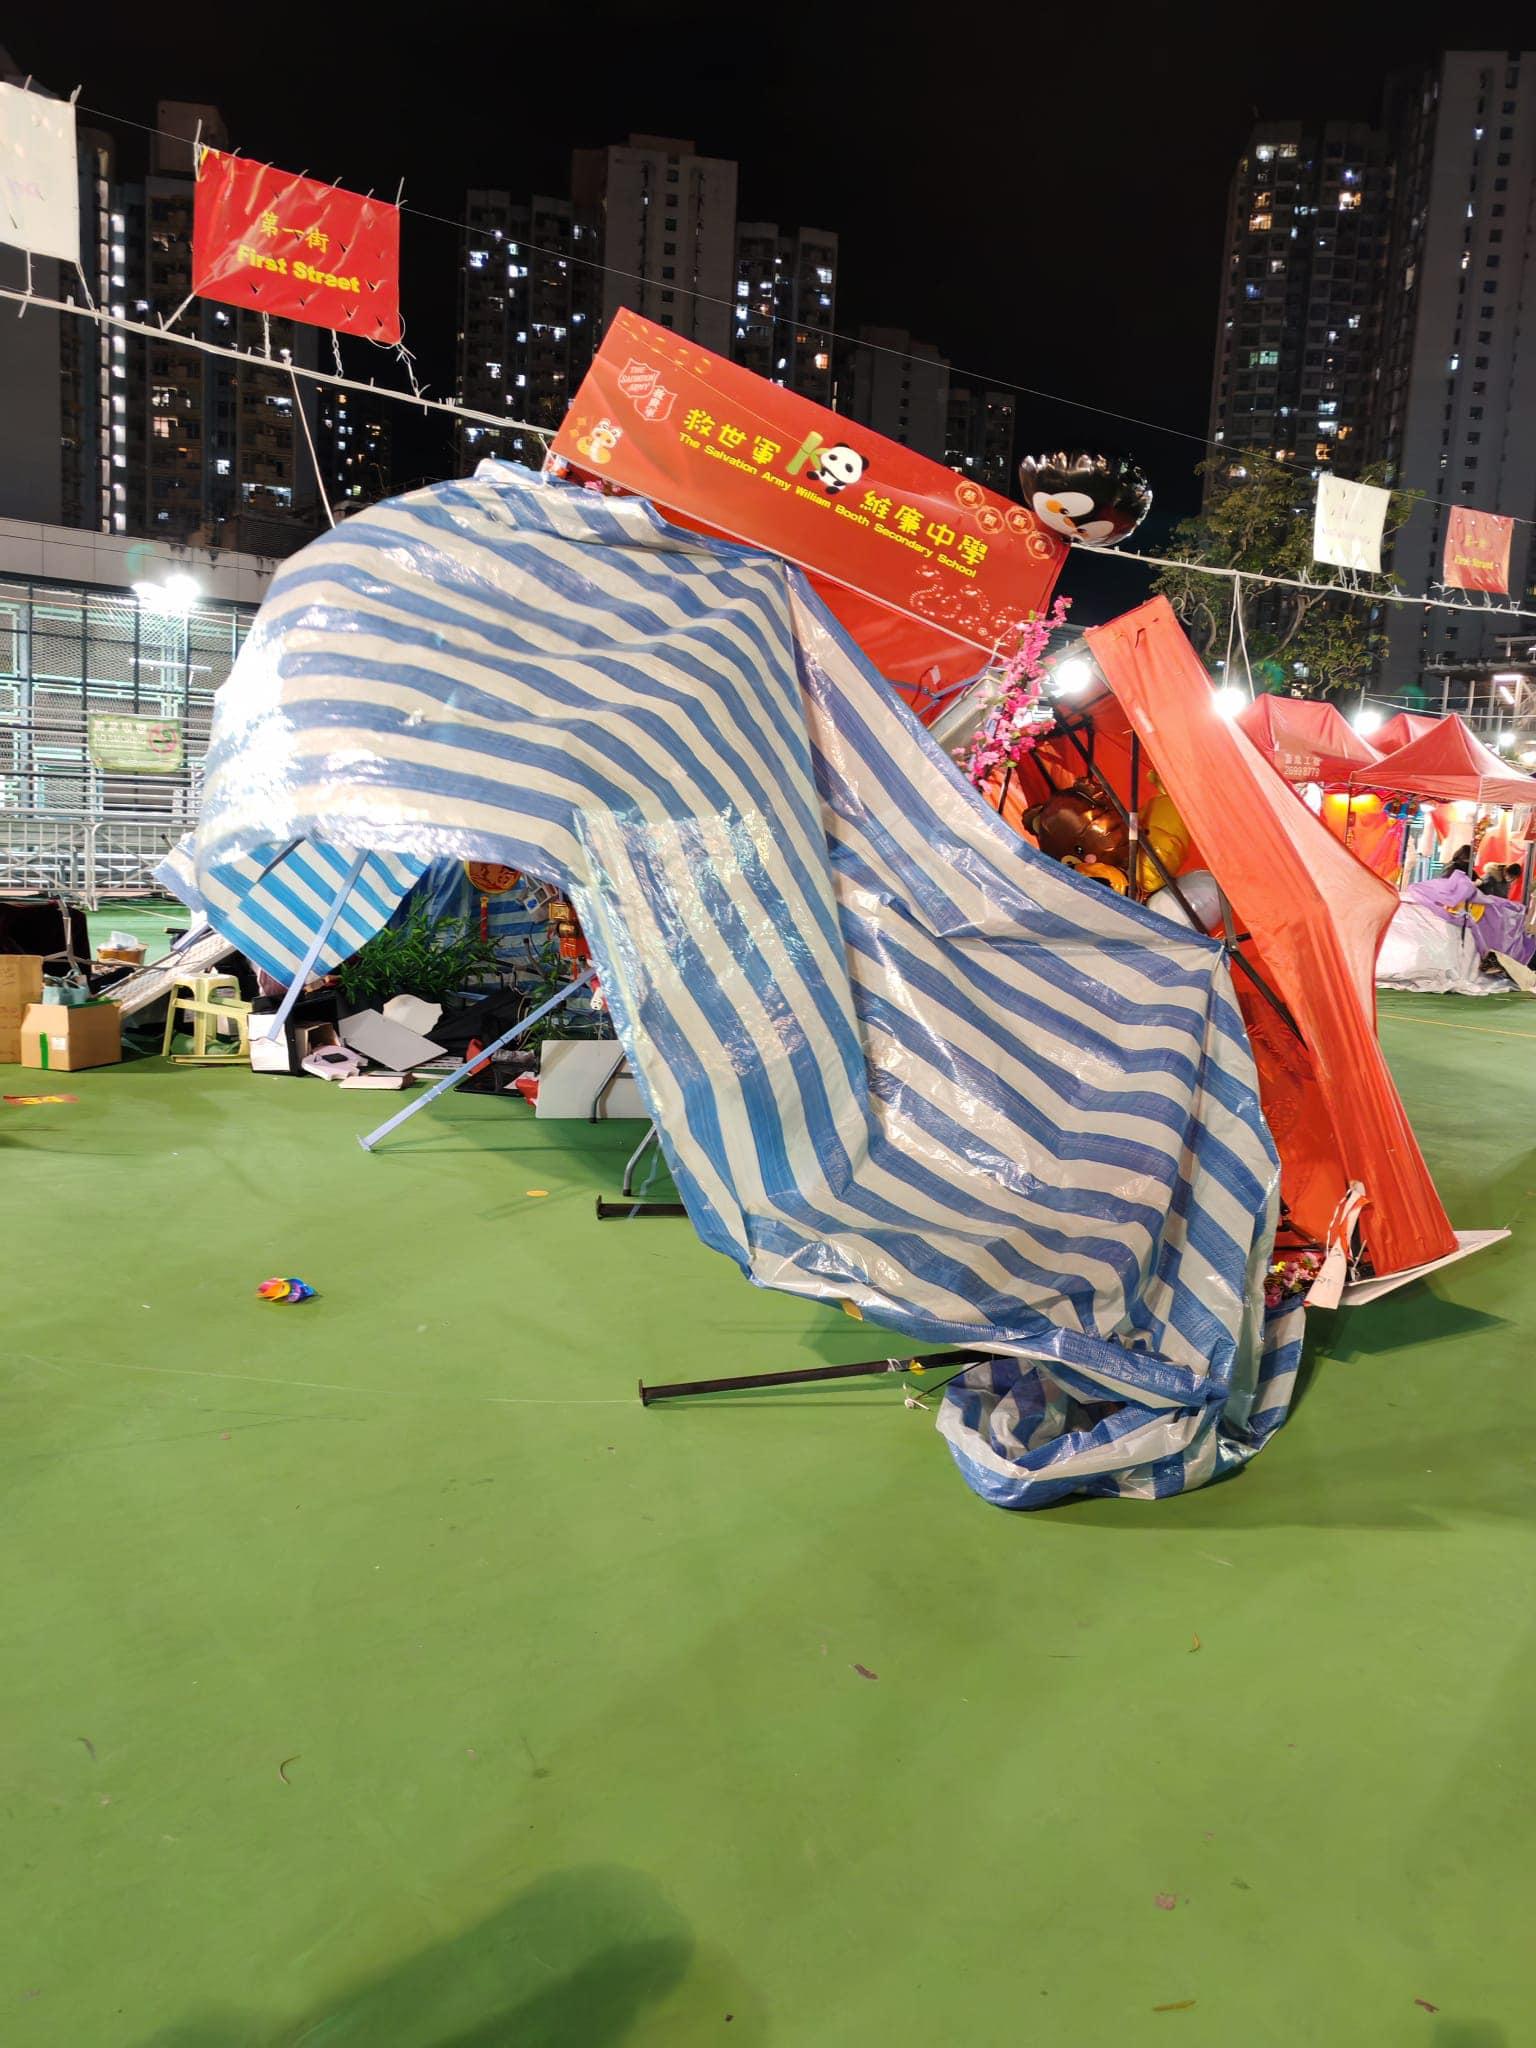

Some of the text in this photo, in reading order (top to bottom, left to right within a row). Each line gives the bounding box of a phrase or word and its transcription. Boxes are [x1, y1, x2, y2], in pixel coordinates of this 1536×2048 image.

[237, 244, 360, 293] First Street
[260, 210, 329, 254] 第一街
[679, 431, 977, 579] The Salvation Army William Booth Secondary School
[683, 408, 989, 566] 救世軍 維廉中學
